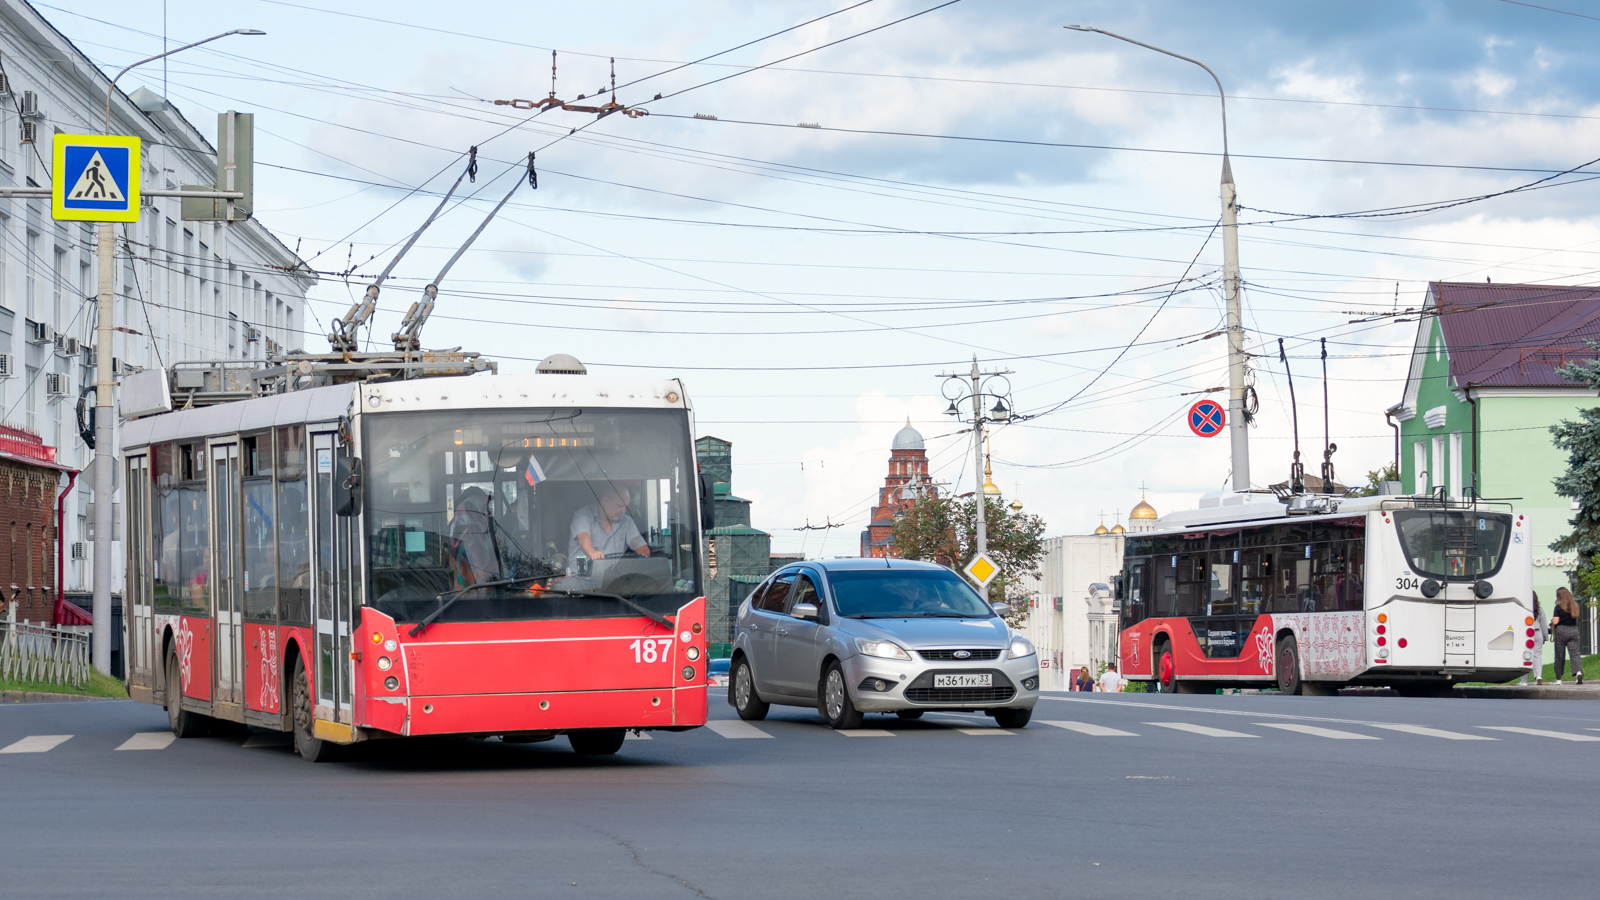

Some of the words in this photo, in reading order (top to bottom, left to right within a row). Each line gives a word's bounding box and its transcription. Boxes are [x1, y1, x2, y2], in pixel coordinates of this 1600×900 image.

[1479, 518, 1486, 530] 8
[1396, 577, 1419, 590] 304
[629, 638, 673, 663] 187
[979, 674, 989, 683] 33
